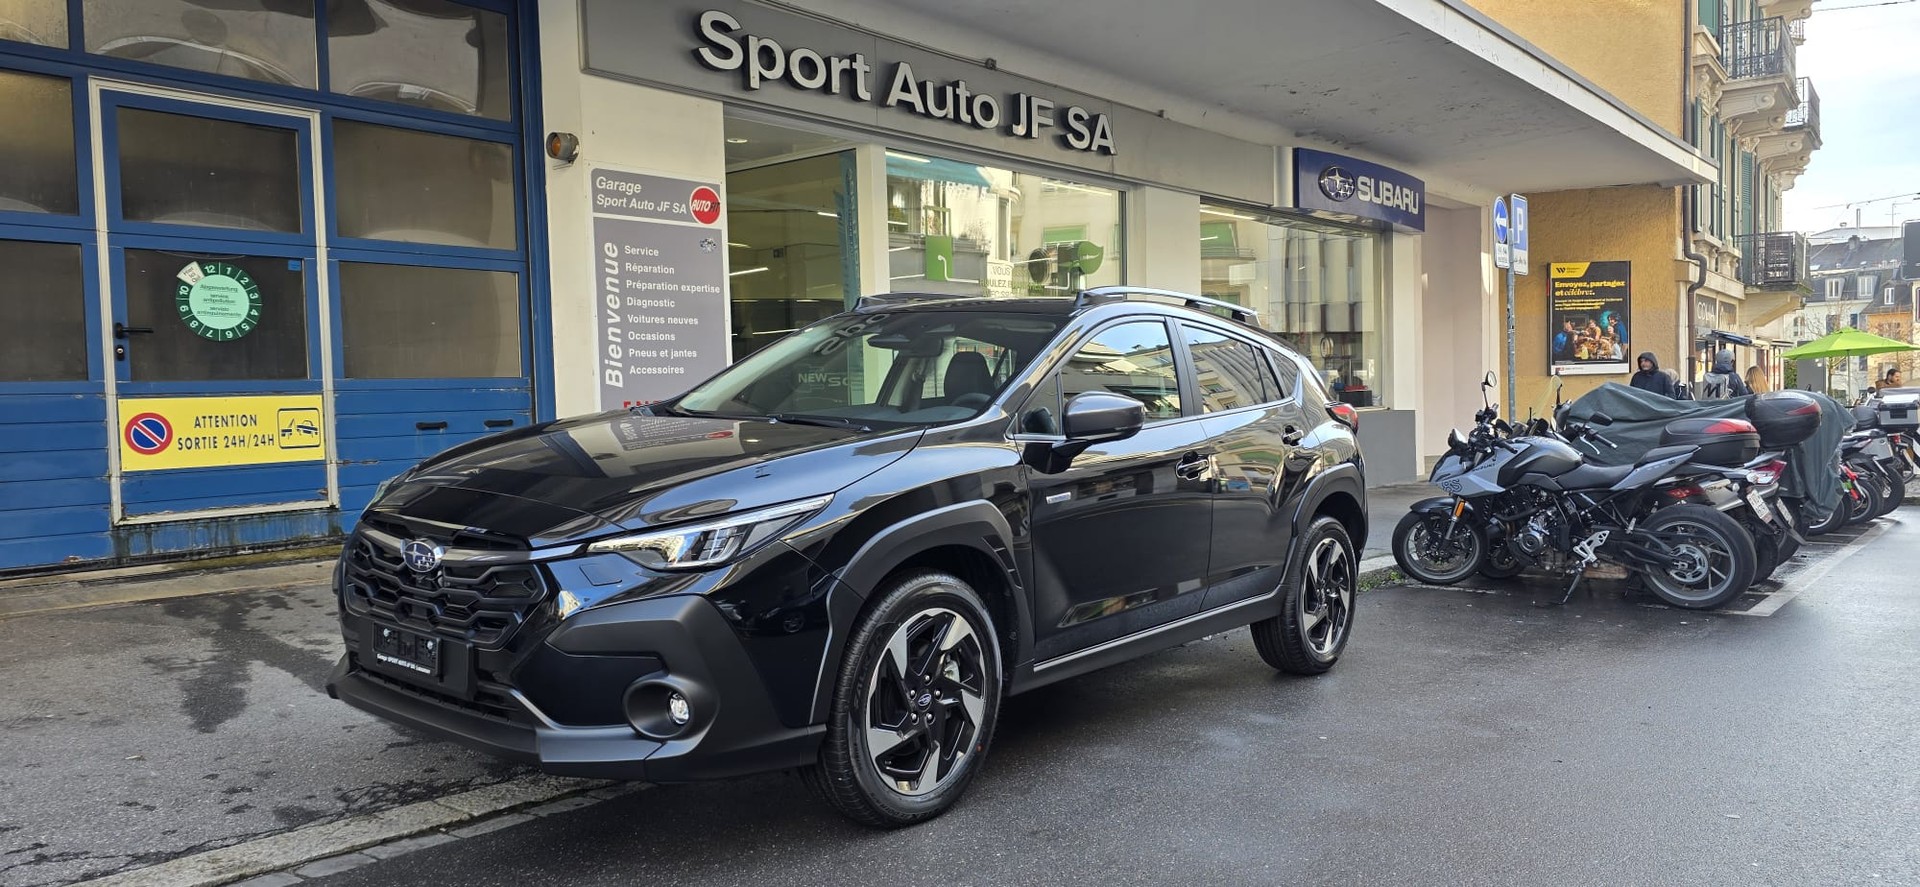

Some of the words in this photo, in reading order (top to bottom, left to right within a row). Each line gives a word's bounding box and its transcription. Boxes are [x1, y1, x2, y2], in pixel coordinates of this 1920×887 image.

[697, 9, 872, 101] Sport
[886, 61, 1000, 129] Auto
[1010, 92, 1055, 139] JF
[1064, 106, 1118, 155] SA
[596, 176, 642, 195] Garage
[1357, 175, 1419, 215] SUBARU
[596, 194, 627, 208] Sport
[629, 198, 655, 211] Auto
[657, 201, 671, 212] JF
[672, 202, 687, 214] SA
[1516, 207, 1524, 244] P
[624, 245, 659, 257] Service
[204, 265, 216, 274] 12
[226, 267, 232, 275] 1
[625, 262, 675, 275] Réparation
[240, 277, 249, 285] 2
[626, 279, 679, 292] Préparation
[681, 283, 720, 294] expertise
[179, 285, 189, 295] 10
[627, 297, 676, 308] Diagnostic
[604, 242, 624, 388] Bienvenue
[628, 314, 665, 325] Voitures
[667, 316, 699, 325] neuves
[190, 320, 198, 328] 8
[241, 323, 250, 331] 5
[628, 331, 676, 341] Occasions
[629, 349, 657, 358] Pneus
[659, 350, 669, 358] et
[670, 349, 697, 360] jantes
[630, 365, 685, 375] Accessoires
[798, 373, 828, 383] NEW
[194, 414, 258, 429] ATTENTION
[177, 436, 218, 451] SORTIE
[223, 434, 275, 450] 24H/24H
